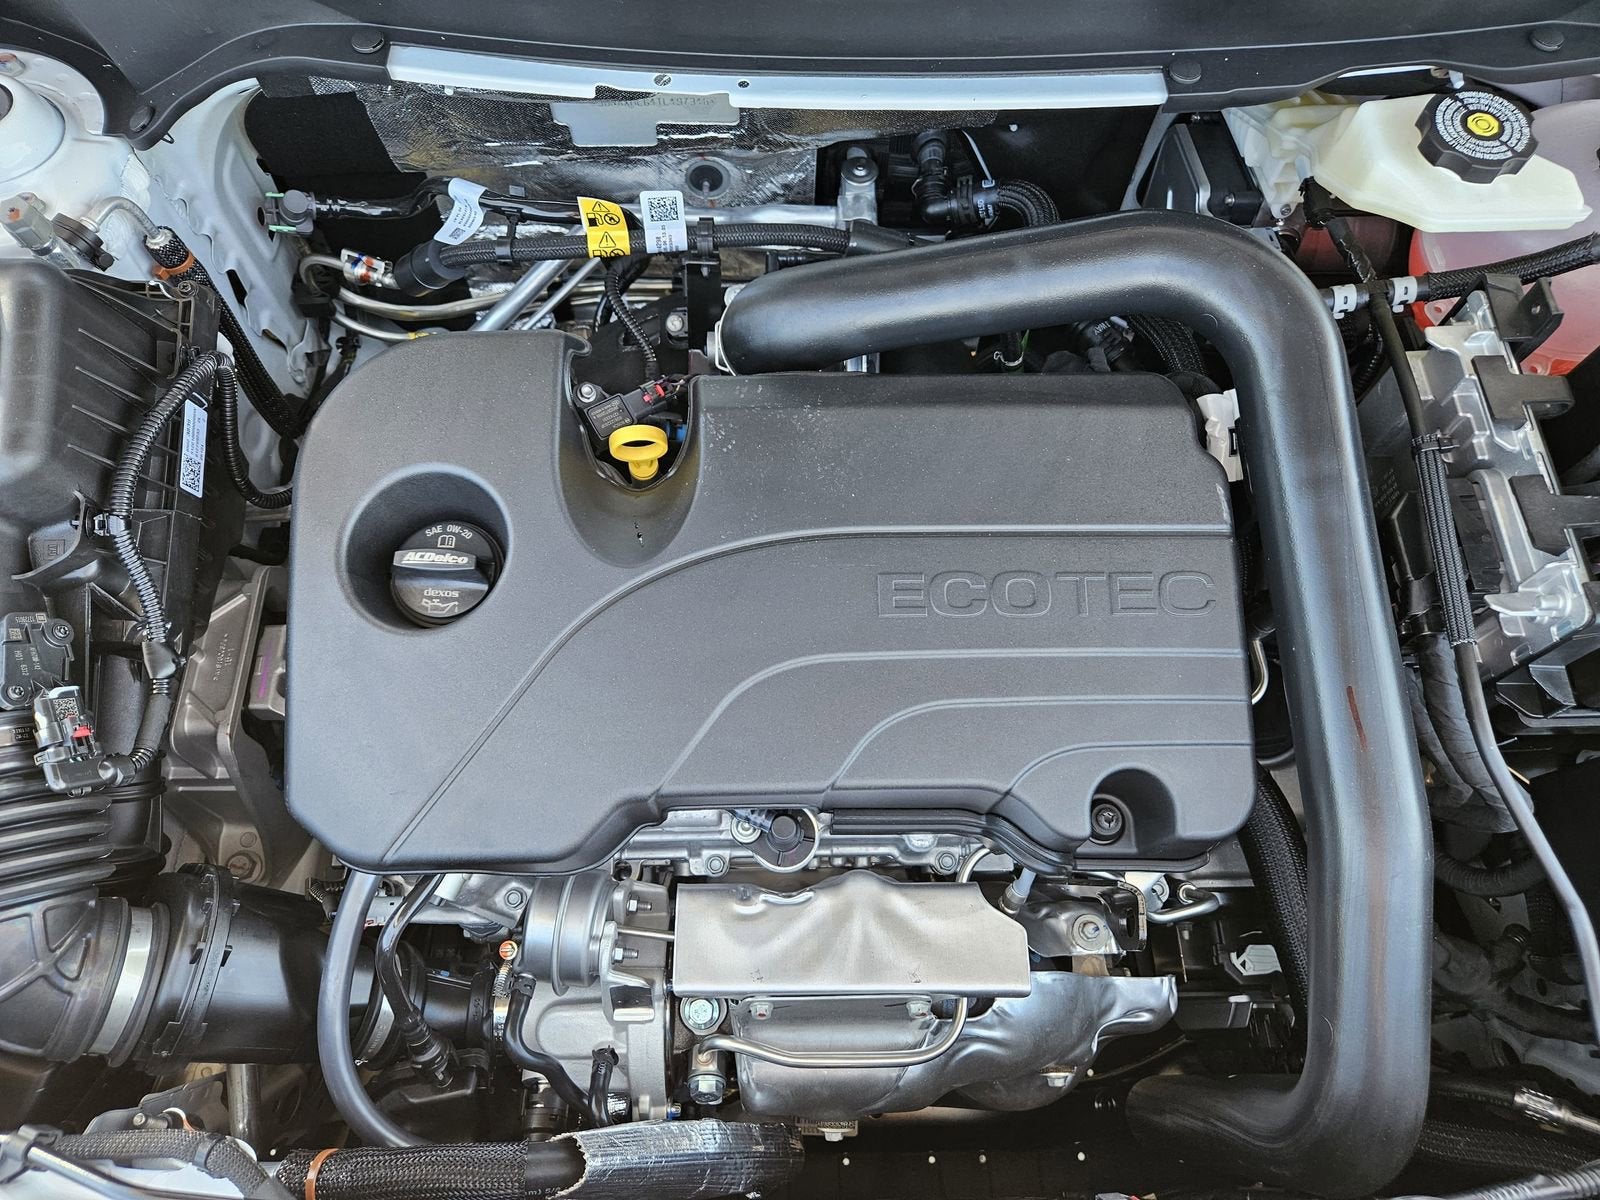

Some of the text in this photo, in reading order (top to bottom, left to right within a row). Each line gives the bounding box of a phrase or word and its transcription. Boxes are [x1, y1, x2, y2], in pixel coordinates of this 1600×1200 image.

[425, 524, 473, 539] SAE 0W-20
[402, 551, 469, 564] ACDelco
[423, 588, 460, 598] dexos
[877, 570, 1216, 617] ECOTEC
